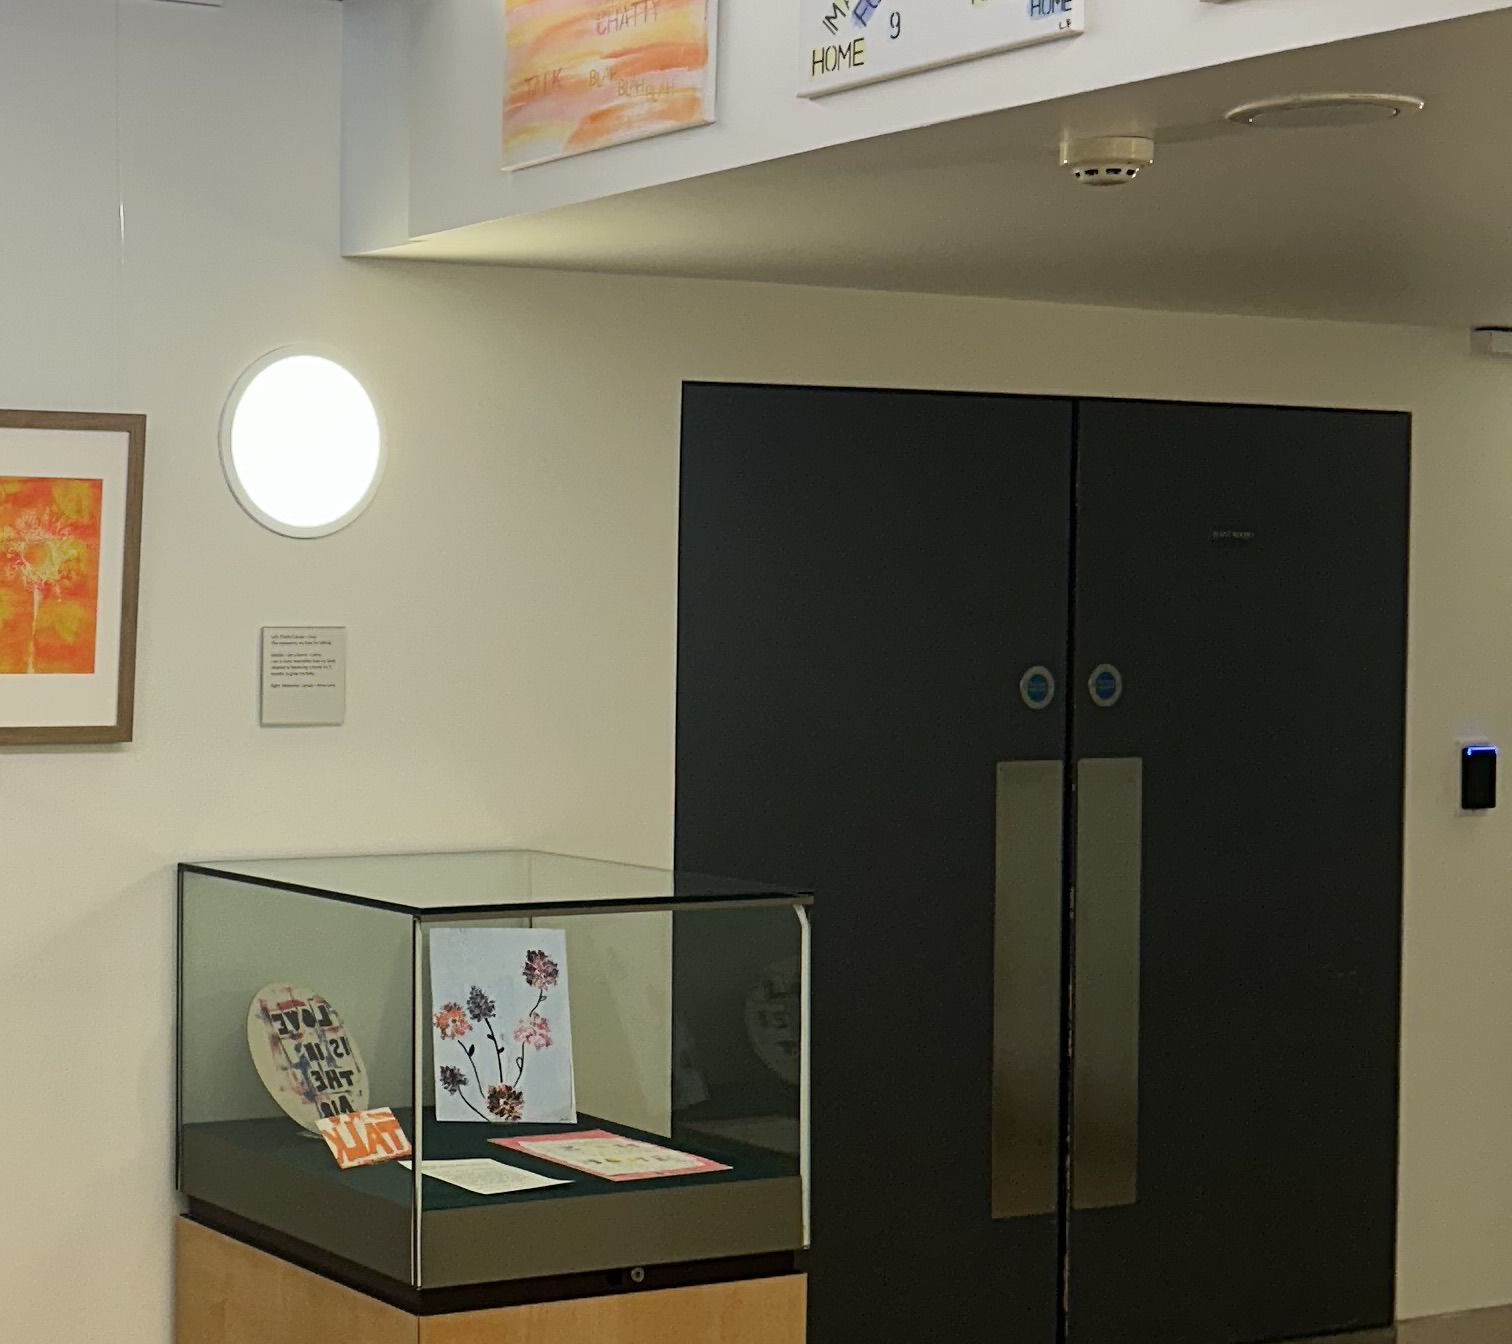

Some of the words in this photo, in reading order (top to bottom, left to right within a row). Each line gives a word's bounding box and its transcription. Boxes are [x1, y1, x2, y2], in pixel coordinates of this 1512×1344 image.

[822, 2, 847, 36] IM
[889, 11, 901, 40] 9
[811, 37, 865, 77] HOME
